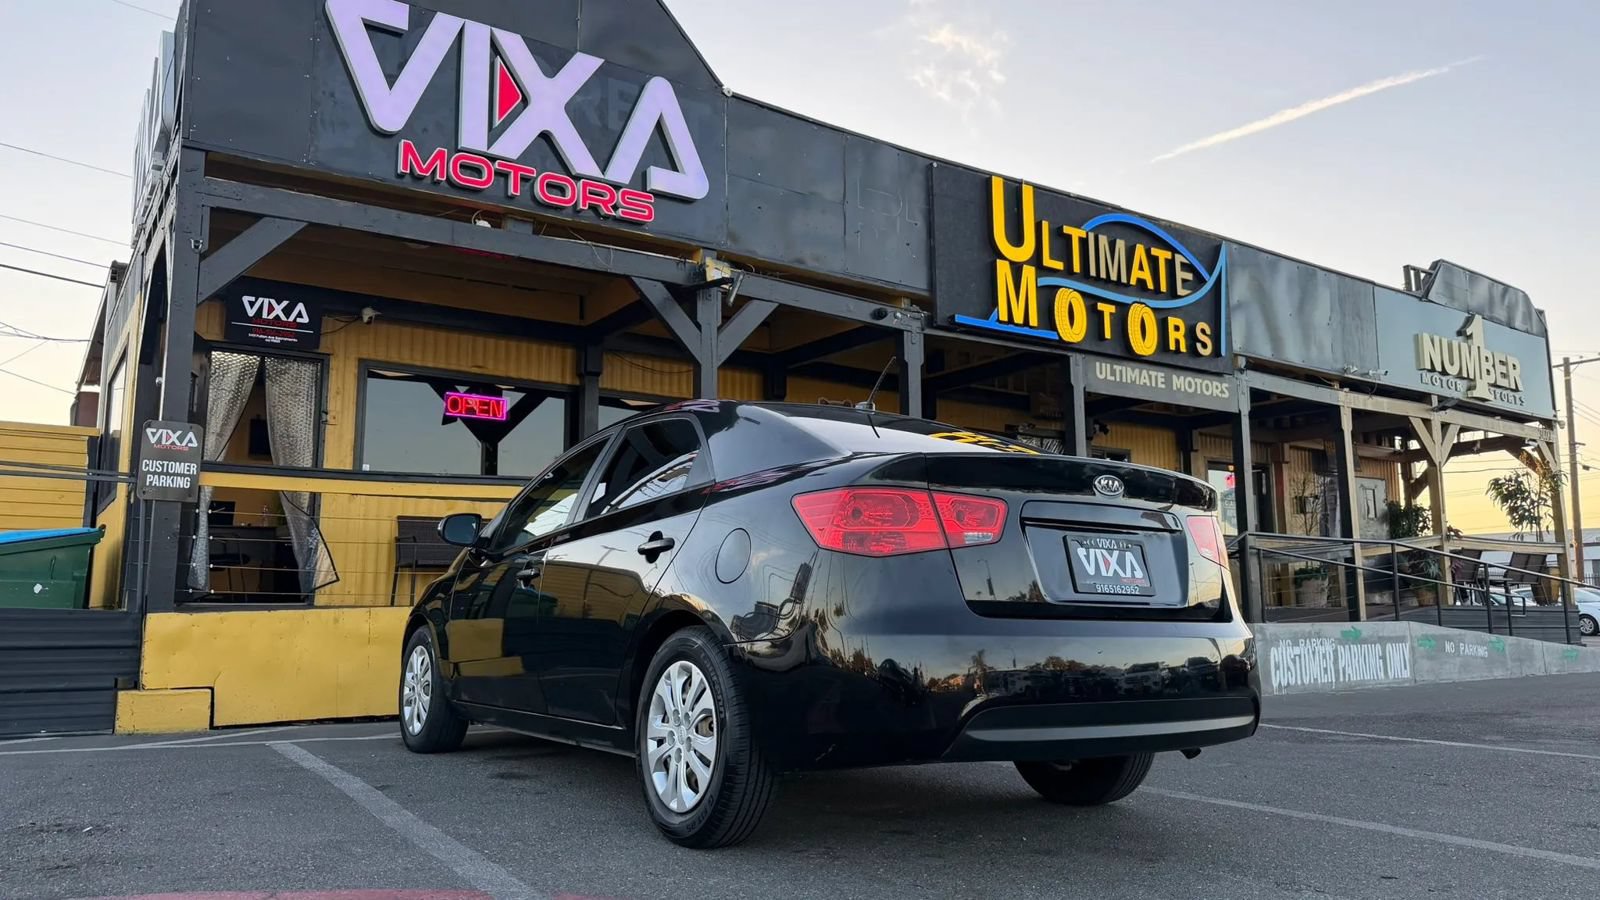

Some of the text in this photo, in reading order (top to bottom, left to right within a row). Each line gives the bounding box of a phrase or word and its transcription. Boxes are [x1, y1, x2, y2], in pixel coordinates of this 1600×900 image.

[326, 0, 709, 199] VIXA
[398, 139, 655, 223] MOTORS
[991, 175, 1194, 297] ULTIMATE
[241, 295, 310, 324] VIXA
[996, 258, 1213, 357] MOTORS
[1417, 332, 1524, 392] NUMBER
[1095, 361, 1230, 398] ULTIMATE MOTORS
[447, 395, 503, 418] OPEN
[145, 427, 198, 448] VIXA
[142, 459, 197, 475] CUSTOMER
[146, 474, 191, 489] PARKING
[1100, 478, 1120, 492] KIA
[1096, 538, 1118, 549] VIXA
[1077, 547, 1144, 579] VIXA
[1095, 584, 1140, 595] 9165162952
[1445, 640, 1488, 658] NO PARKING
[1270, 642, 1410, 687] CUSTOMER PARKING ONLY
